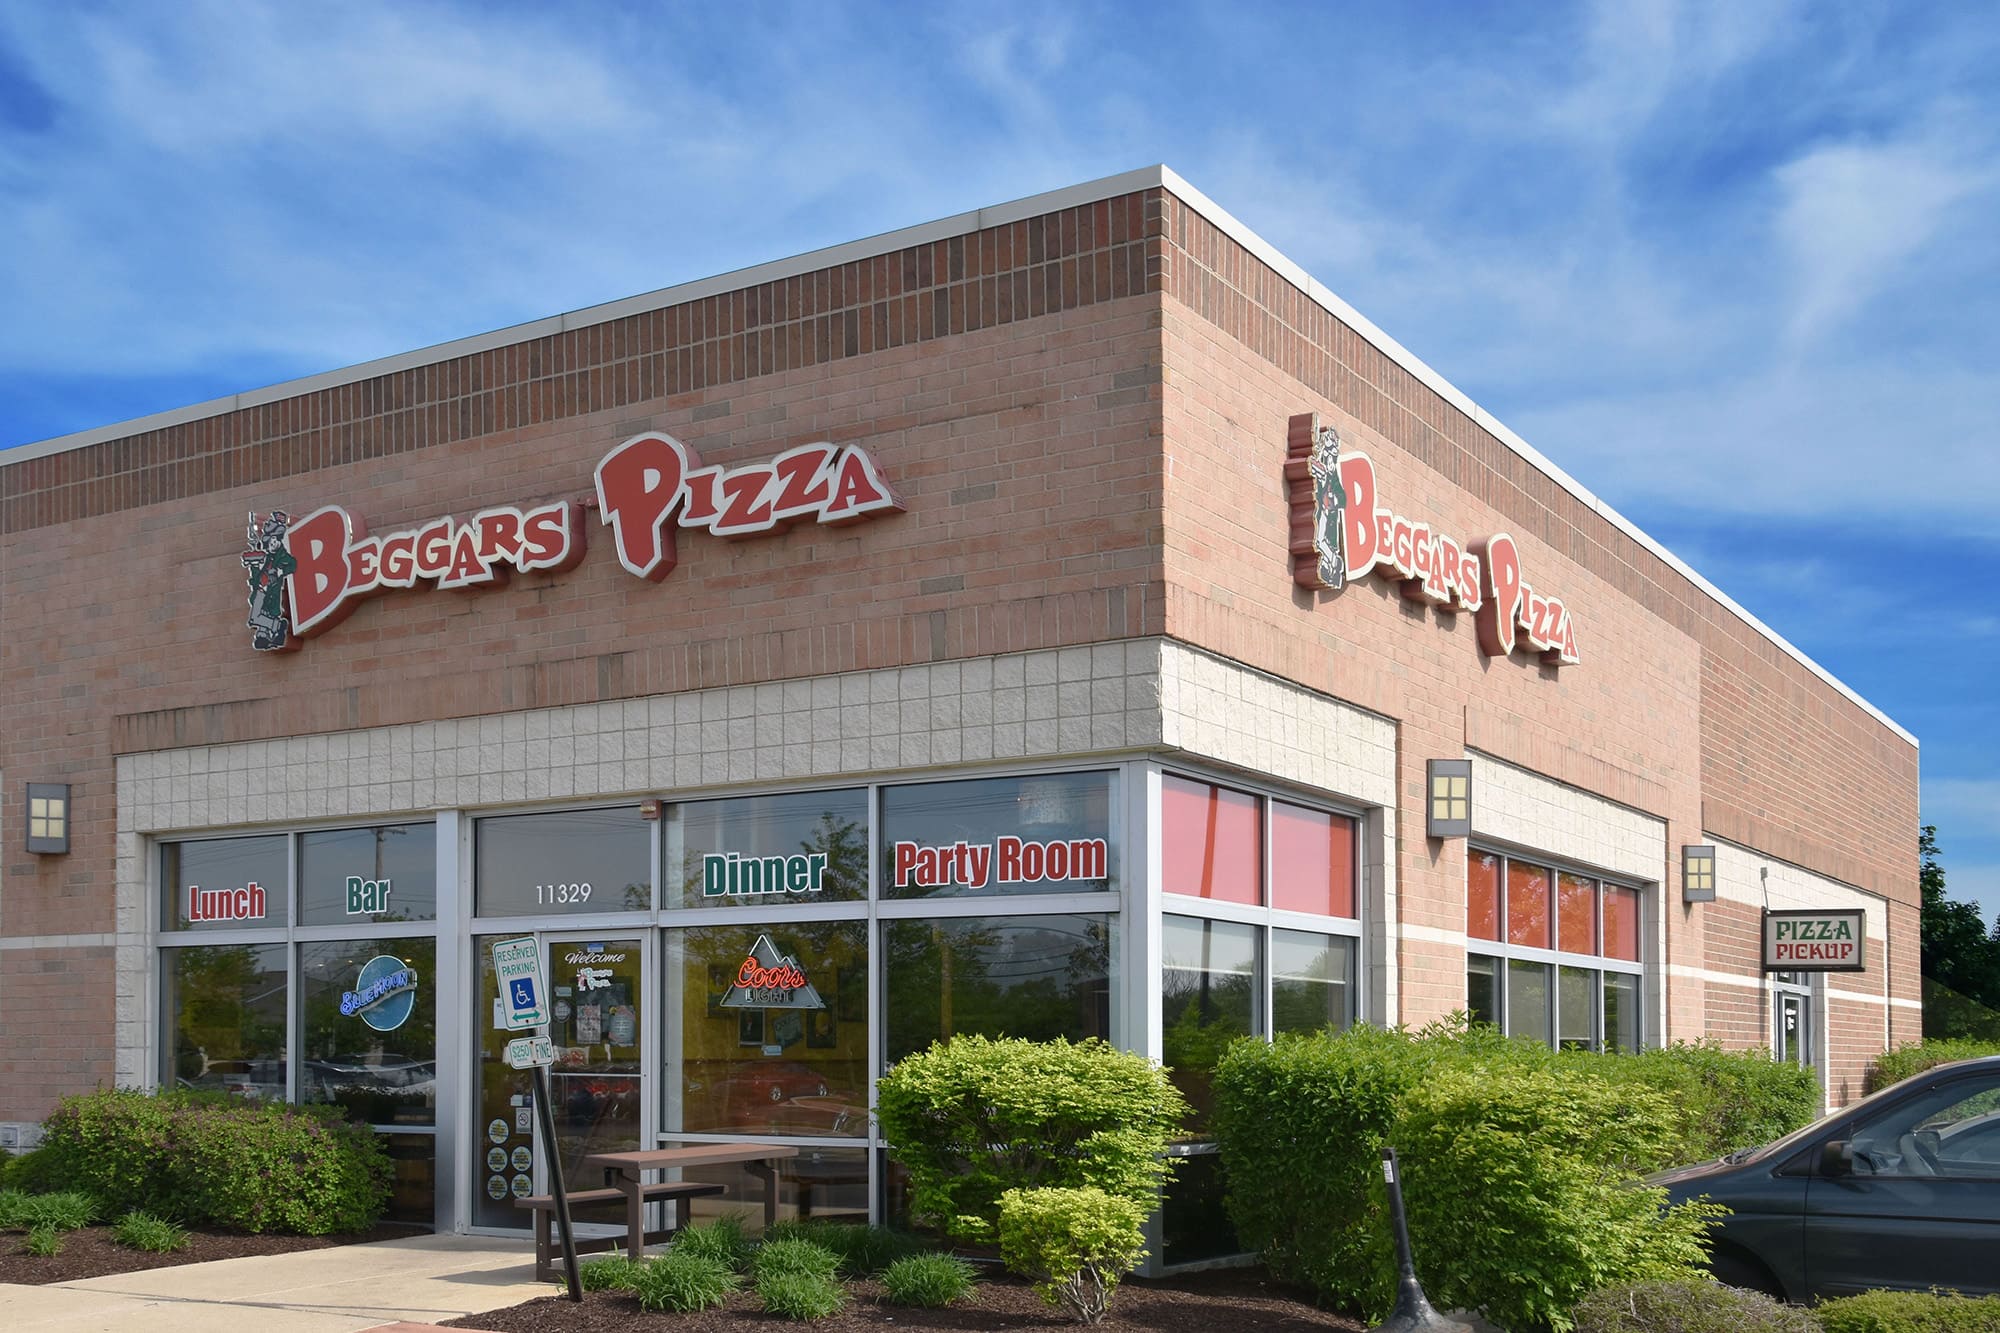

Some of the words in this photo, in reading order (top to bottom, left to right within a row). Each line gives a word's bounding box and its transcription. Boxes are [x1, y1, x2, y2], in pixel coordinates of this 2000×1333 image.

[288, 501, 571, 635] BEGGARS
[595, 431, 893, 579] PIZZA
[1338, 451, 1482, 611] BEGGARS
[1488, 533, 1580, 664] PIZZA
[895, 841, 992, 889] Party
[997, 836, 1107, 883] Room
[704, 852, 827, 897] Dinner
[189, 882, 265, 921] Lunch
[346, 876, 390, 914] Bar
[536, 883, 592, 904] 11329
[1775, 920, 1852, 940] PIZZA
[496, 945, 536, 962] RESERVED
[565, 951, 626, 965] Welcome
[1775, 943, 1853, 960] PICKUP
[501, 961, 536, 976] PARKING
[734, 956, 806, 990] Coors
[745, 988, 792, 1002] LIGHT
[512, 1044, 530, 1059] $250
[535, 1042, 552, 1060] FINE
